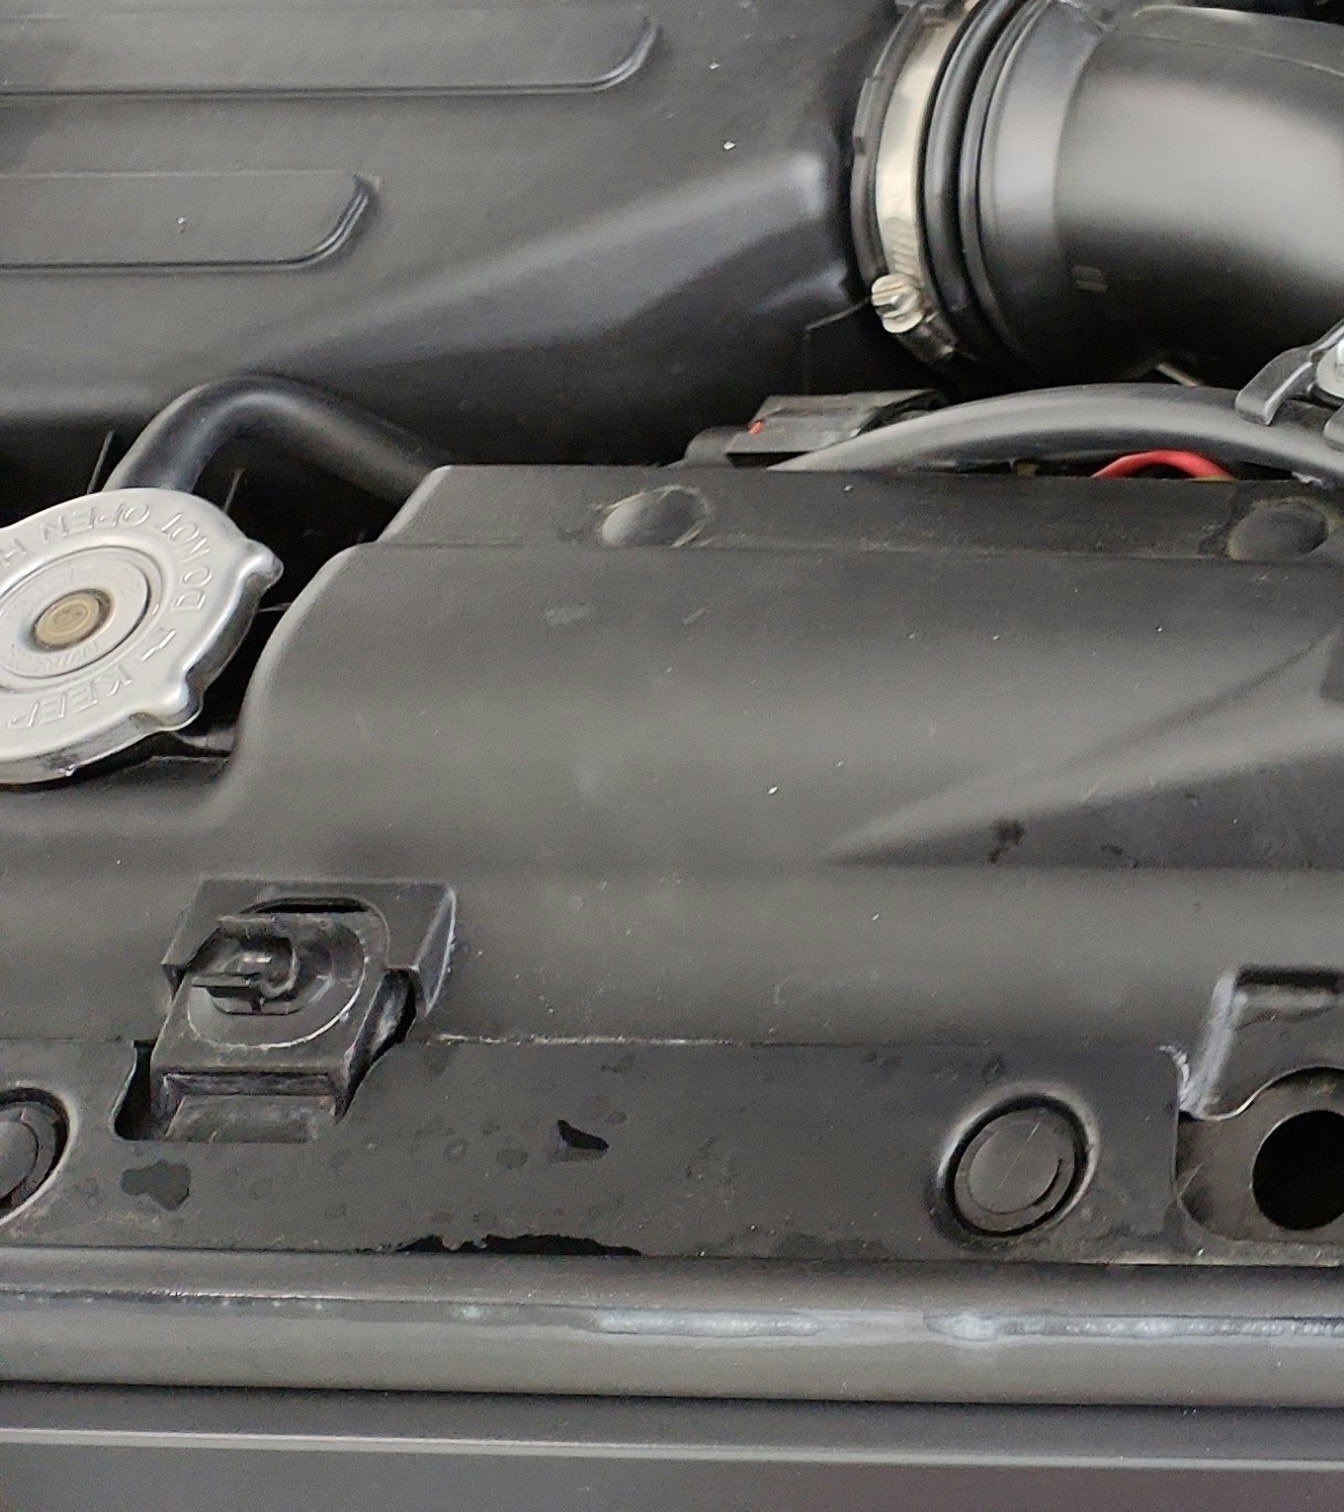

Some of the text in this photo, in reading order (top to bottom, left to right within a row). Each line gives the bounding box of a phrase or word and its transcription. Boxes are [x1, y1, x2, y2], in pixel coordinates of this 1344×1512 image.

[40, 502, 212, 613] DO NOT OPEN
[6, 662, 133, 730] KEEP
